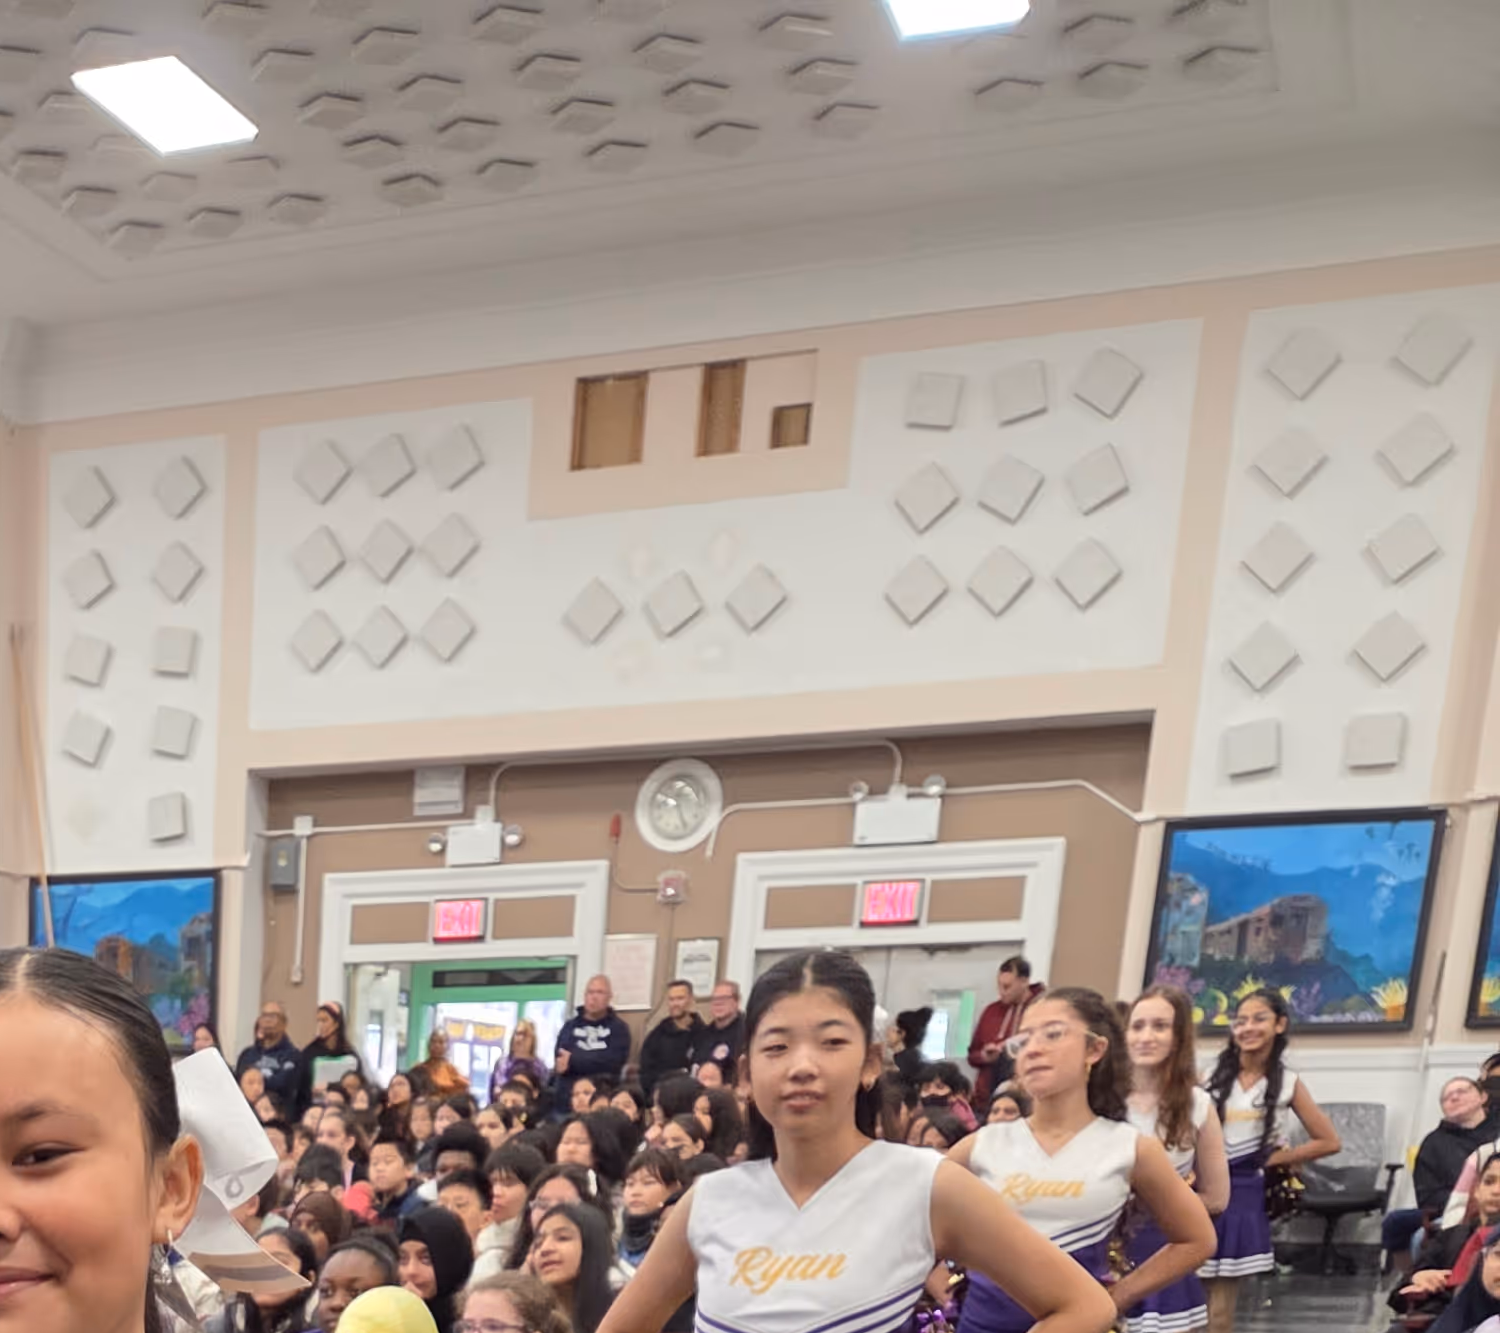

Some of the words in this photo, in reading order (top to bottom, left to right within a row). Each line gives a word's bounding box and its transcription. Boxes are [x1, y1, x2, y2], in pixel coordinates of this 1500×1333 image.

[864, 882, 919, 920] EXIT
[1001, 1172, 1085, 1206] Ryan
[729, 1246, 848, 1296] Ryan
